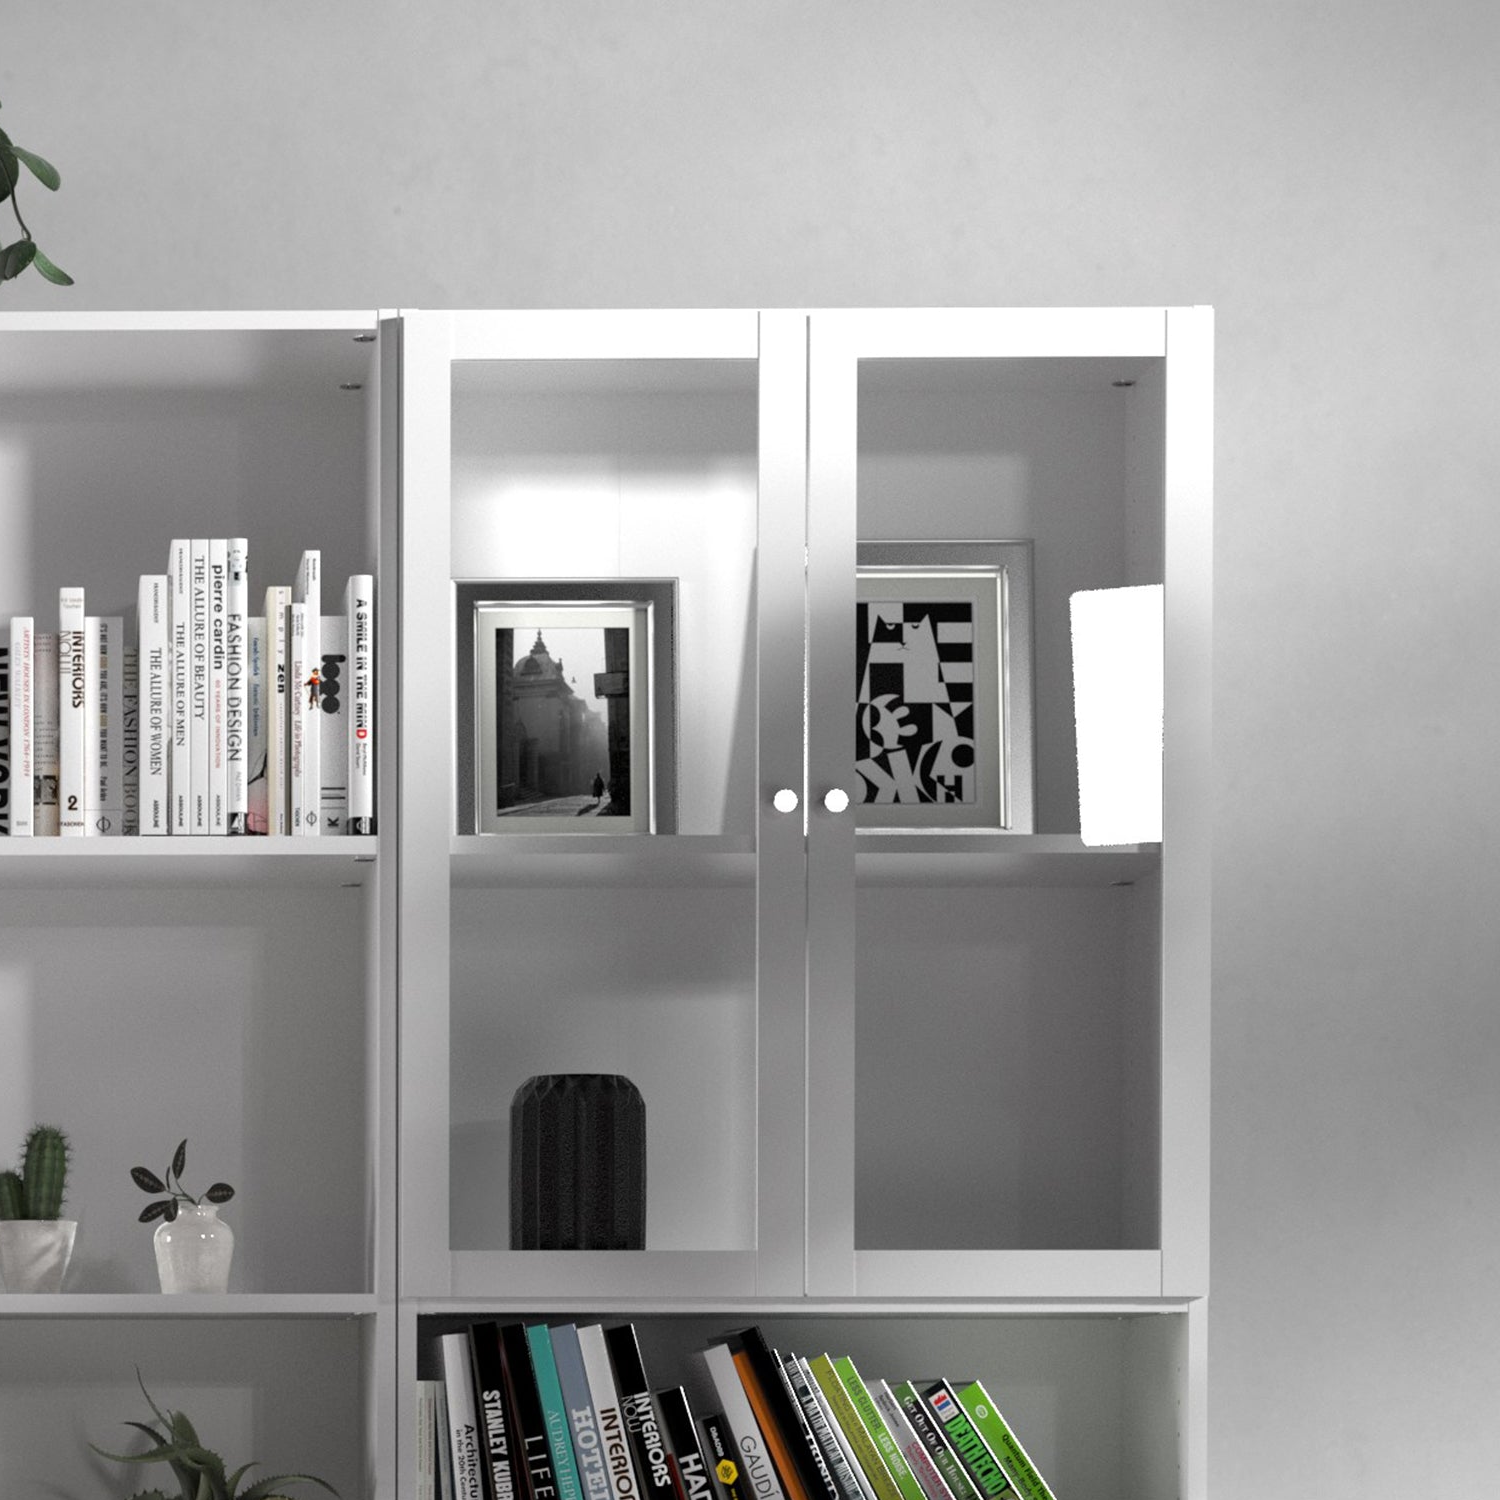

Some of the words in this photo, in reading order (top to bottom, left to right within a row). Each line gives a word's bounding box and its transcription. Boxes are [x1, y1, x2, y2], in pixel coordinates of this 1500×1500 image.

[193, 556, 205, 584] THE
[211, 564, 224, 613] pierre
[193, 587, 205, 640] ALLURE
[356, 599, 367, 608] A
[175, 622, 186, 647] THE
[193, 644, 205, 662] OF
[213, 618, 225, 670] cardin
[228, 613, 242, 695] FASHION
[72, 631, 85, 709] INTERIORS
[124, 649, 137, 689] THE
[149, 647, 162, 671] THE
[175, 650, 186, 697] ALLURE
[294, 660, 303, 679] Linda
[149, 673, 162, 715] ALLURE
[175, 700, 186, 716] OF
[193, 664, 205, 721] BEAUTY
[124, 694, 137, 777] FASHION
[149, 717, 162, 731] OF
[175, 718, 186, 746] MEN
[228, 699, 242, 762] DESIGN
[149, 733, 162, 776] WOMEN
[67, 795, 78, 811] 2
[124, 783, 137, 835] BOOK
[327, 818, 339, 828] K
[845, 1375, 864, 1398] LESS
[482, 1389, 508, 1456] STANLEY
[547, 1409, 569, 1466] AUDREY
[633, 1390, 672, 1488] INTERIORS
[876, 1431, 896, 1455] LESS
[902, 1394, 920, 1416] GET
[913, 1412, 932, 1434] OUT
[924, 1430, 941, 1448] OF
[933, 1445, 952, 1466] OUR
[524, 1435, 555, 1500] LIFE
[740, 1435, 780, 1500] GAUDÍ
[909, 1441, 943, 1488] COMPUTER
[943, 1413, 988, 1465] DEATH
[969, 1453, 1010, 1498] ECHO
[1000, 1433, 1028, 1469] Quantum
[1023, 1467, 1041, 1488] Field
[1001, 1454, 1034, 1499] Many-Body
